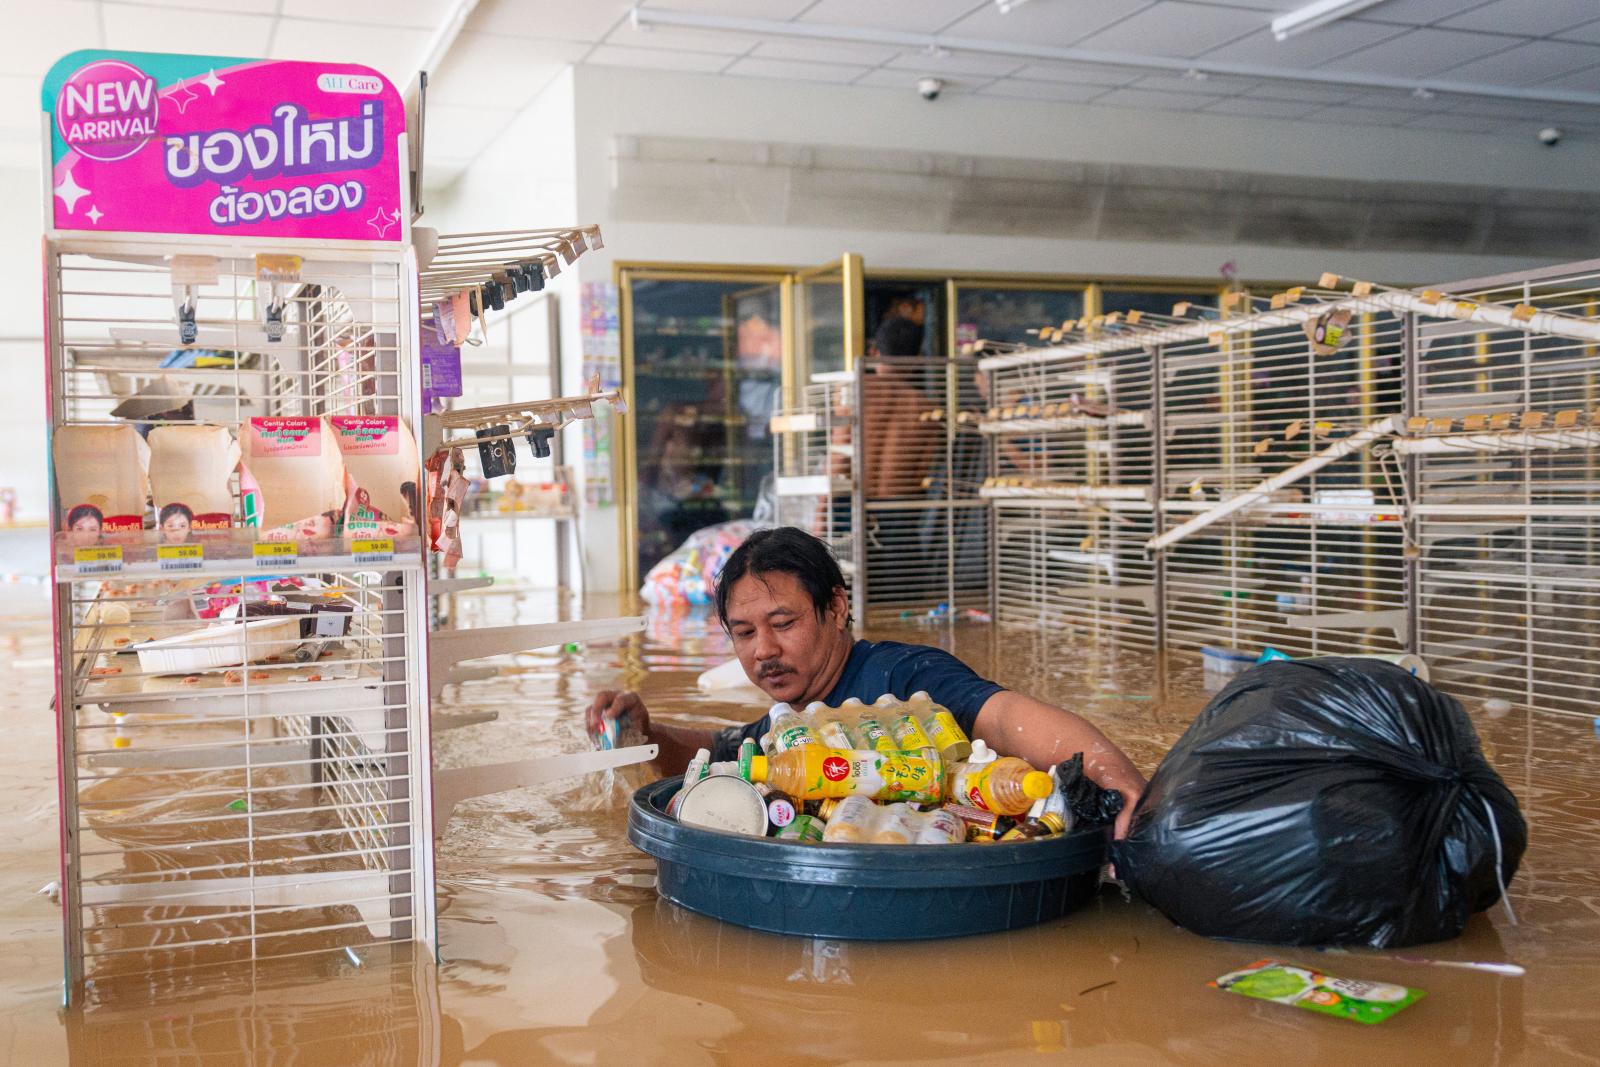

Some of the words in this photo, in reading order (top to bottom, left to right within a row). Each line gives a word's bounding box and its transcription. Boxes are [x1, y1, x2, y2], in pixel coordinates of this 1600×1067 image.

[66, 78, 153, 116] NEW
[348, 79, 378, 90] Care
[67, 117, 155, 142] ARRIVAL
[167, 103, 375, 178] ของใหม่
[209, 180, 363, 224] ต้องลอง
